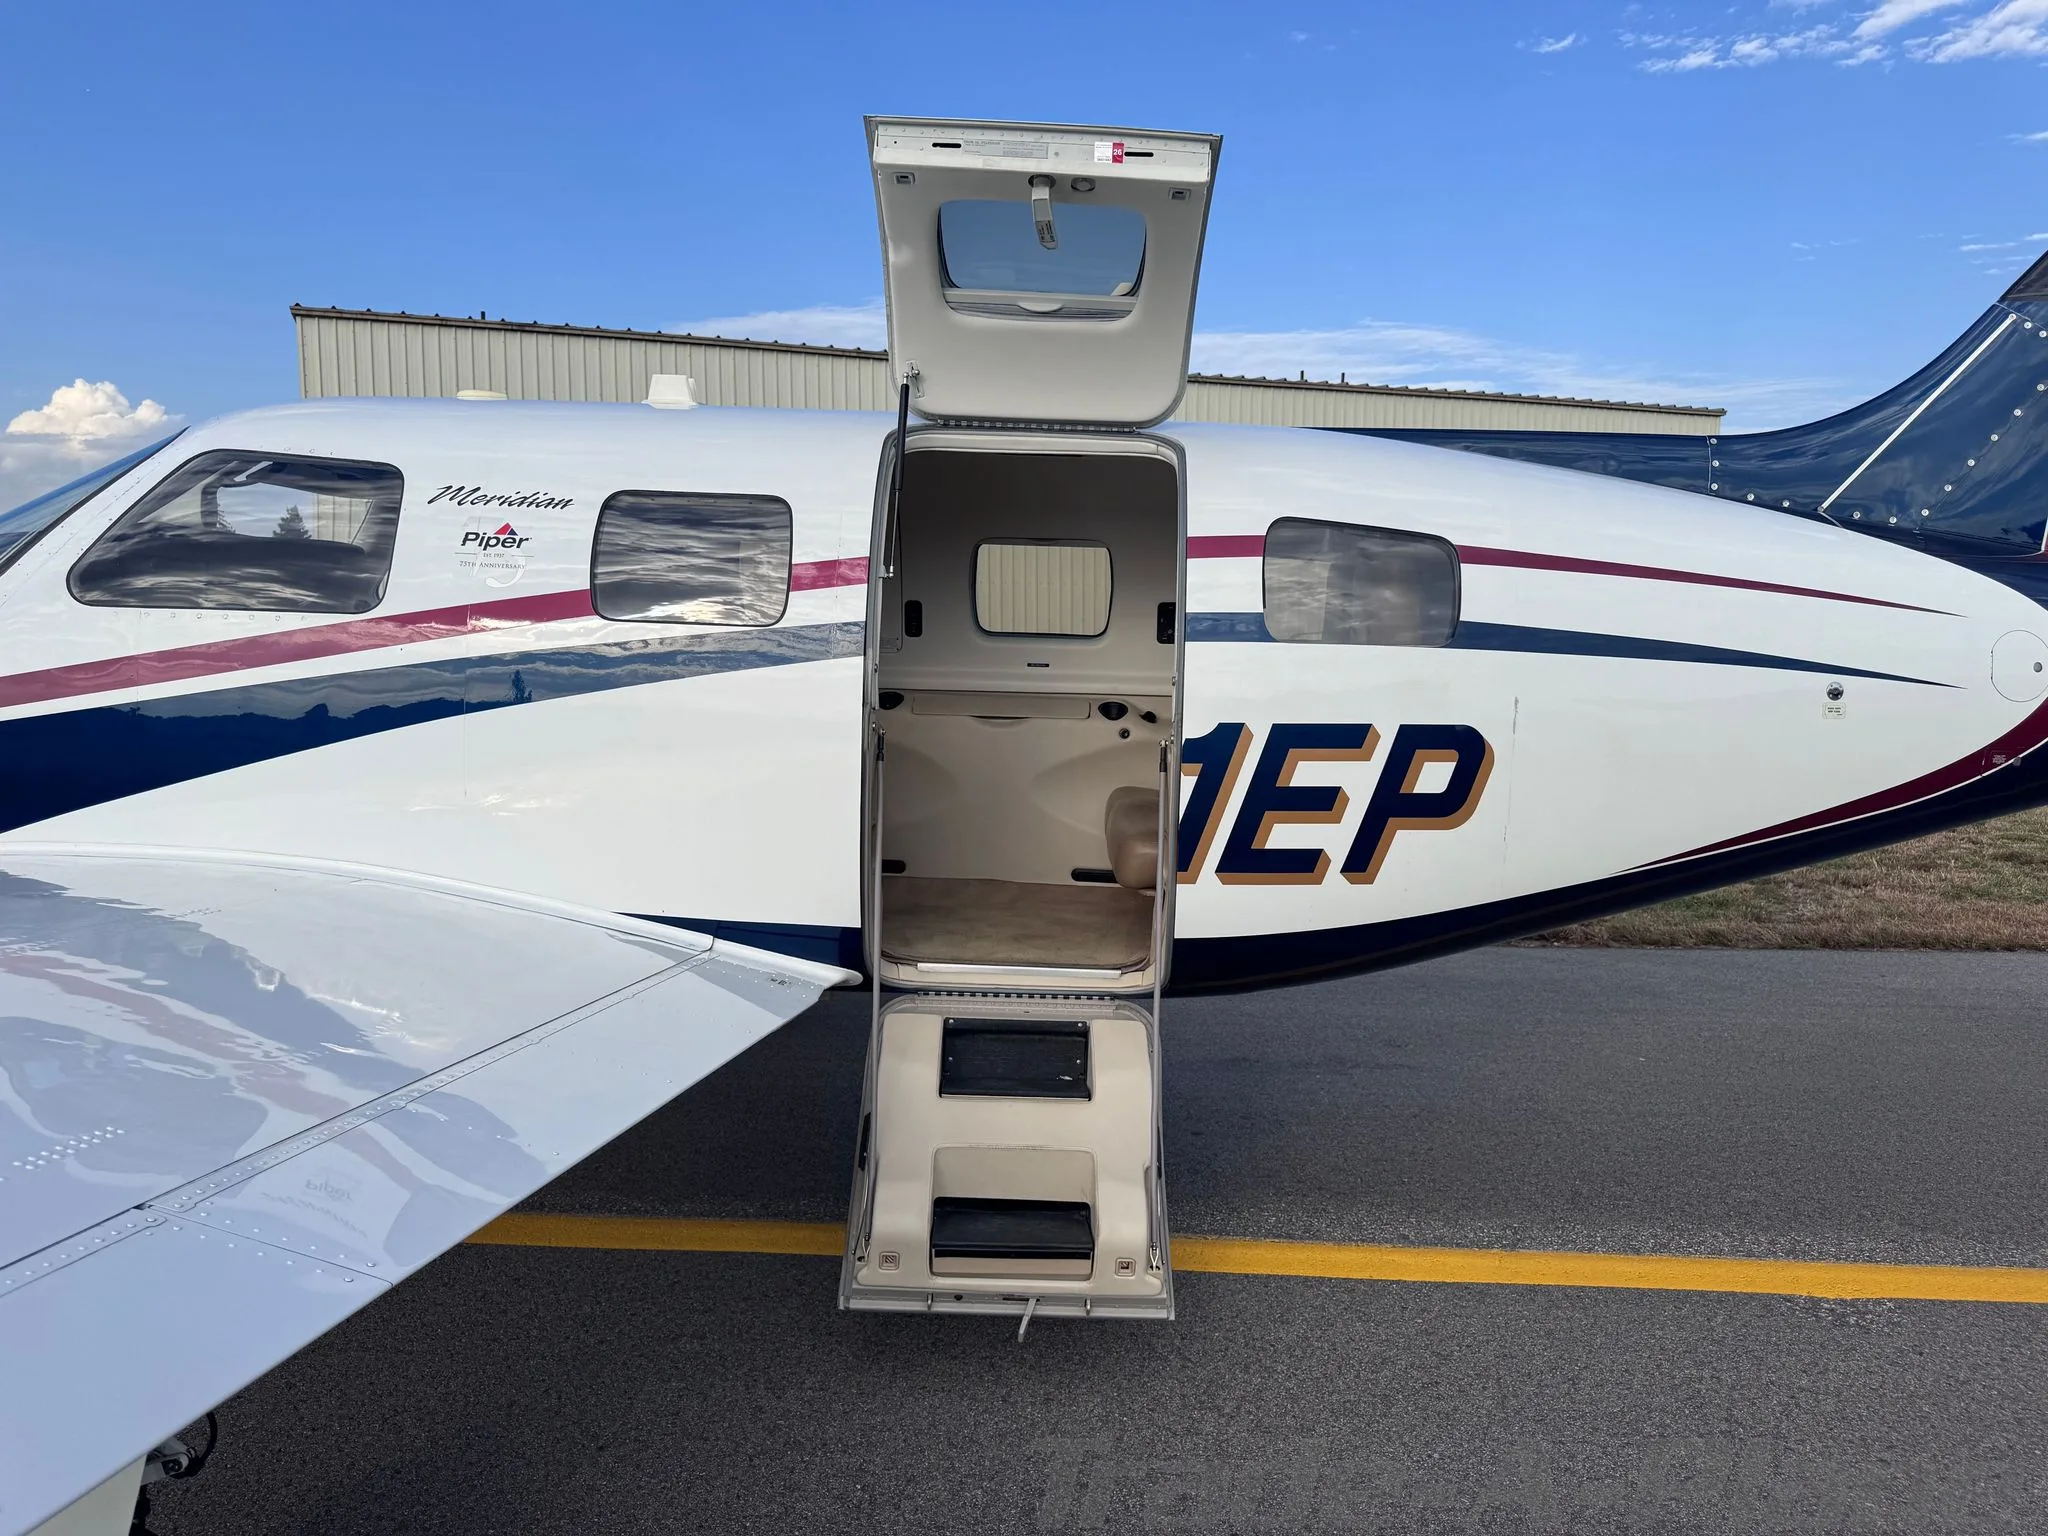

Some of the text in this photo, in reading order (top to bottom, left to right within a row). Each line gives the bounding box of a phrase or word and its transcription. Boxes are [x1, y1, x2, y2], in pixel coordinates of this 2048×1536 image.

[1113, 148, 1123, 156] 26
[427, 485, 575, 510] Meridian
[460, 531, 530, 551] Piper
[480, 561, 525, 569] ANNIVERSARY
[1176, 722, 1495, 885] 1EP
